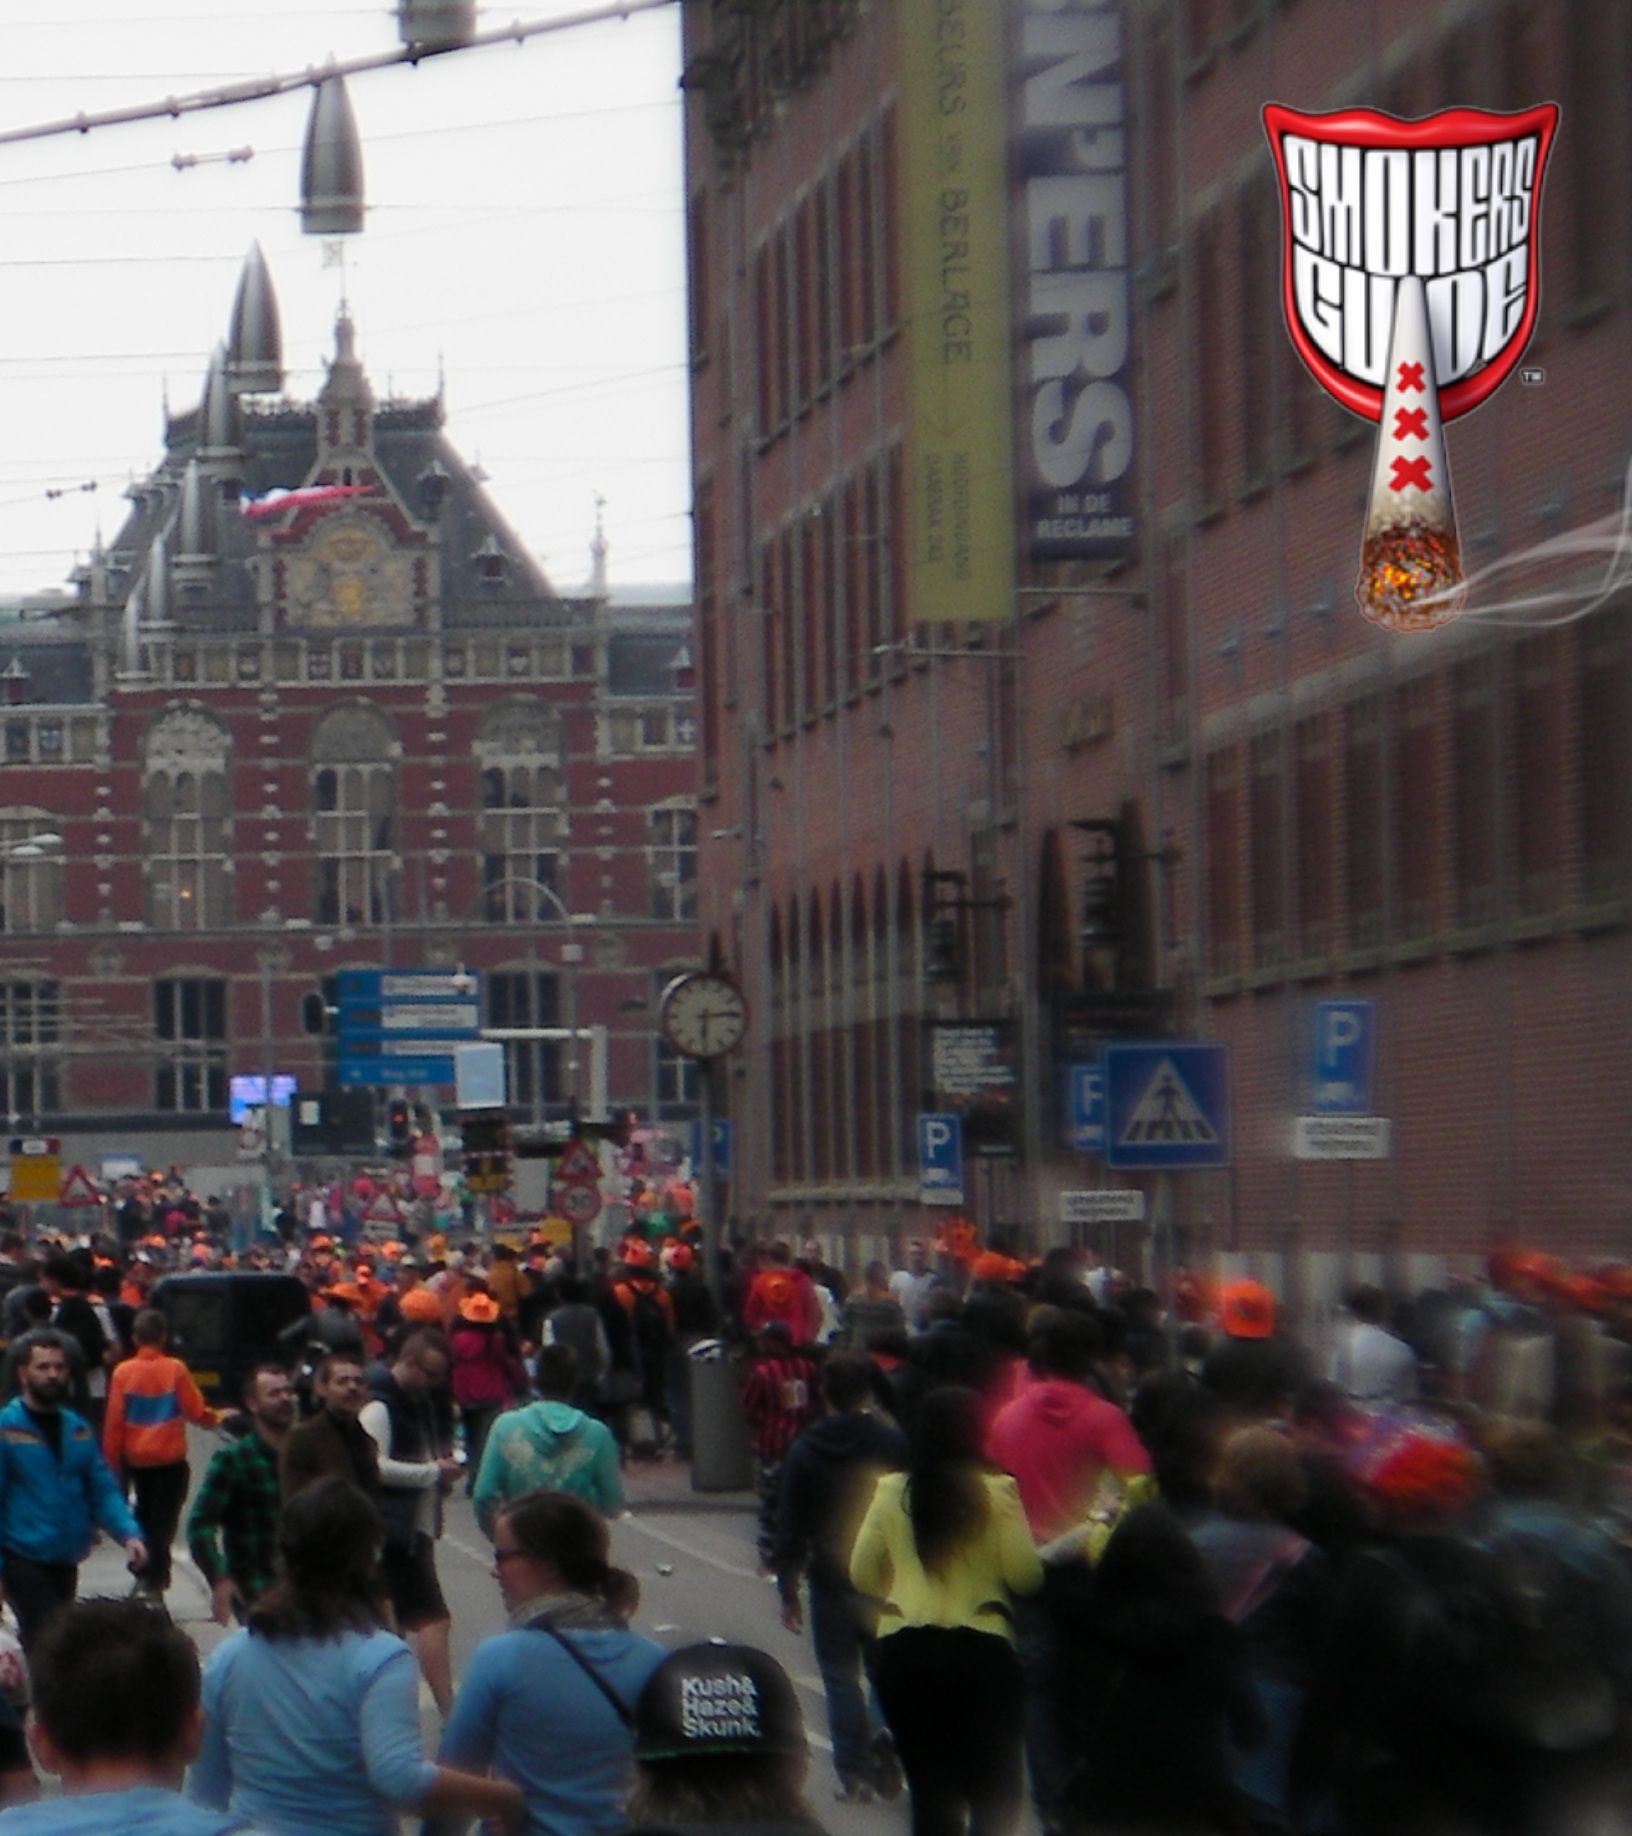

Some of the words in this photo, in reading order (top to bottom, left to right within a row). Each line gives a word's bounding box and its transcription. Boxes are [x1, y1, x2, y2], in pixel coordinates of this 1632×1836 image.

[1021, 0, 1133, 488] N'ERS
[941, 189, 972, 366] BERLAGE
[1036, 516, 1134, 539] RECLAME
[1327, 1011, 1362, 1067] P
[925, 1121, 951, 1159] P
[681, 1674, 758, 1698] Kush&
[681, 1695, 758, 1718] Haze&
